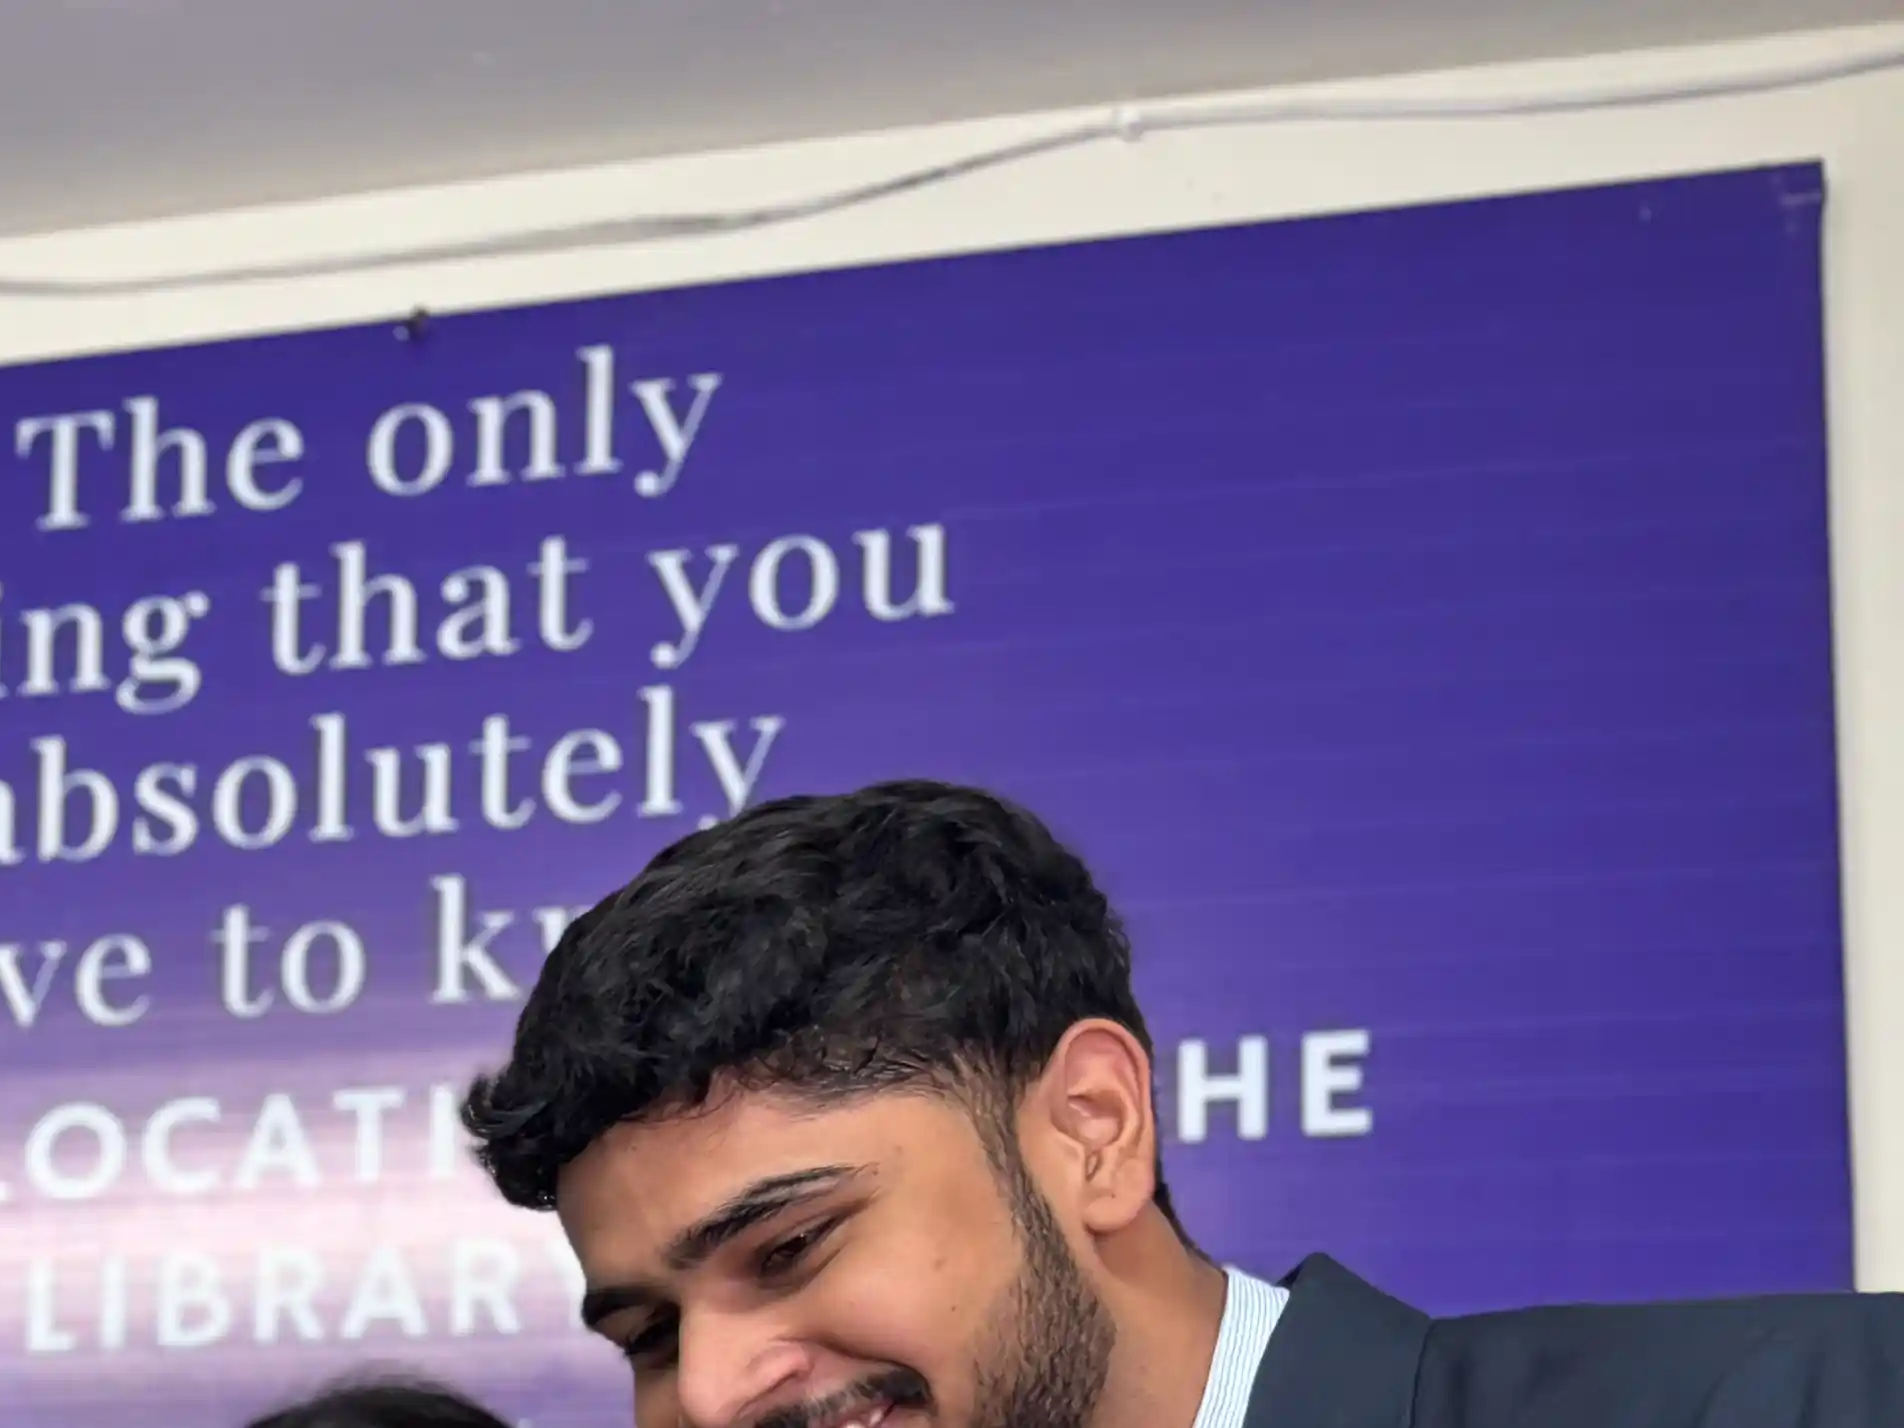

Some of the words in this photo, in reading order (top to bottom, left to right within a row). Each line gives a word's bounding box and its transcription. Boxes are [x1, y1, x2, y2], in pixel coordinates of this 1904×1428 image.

[15, 396, 304, 531] The
[367, 345, 722, 498] only
[261, 535, 593, 676] that
[648, 522, 954, 669] you
[212, 902, 366, 1018] to
[1177, 1029, 1373, 1143] HE
